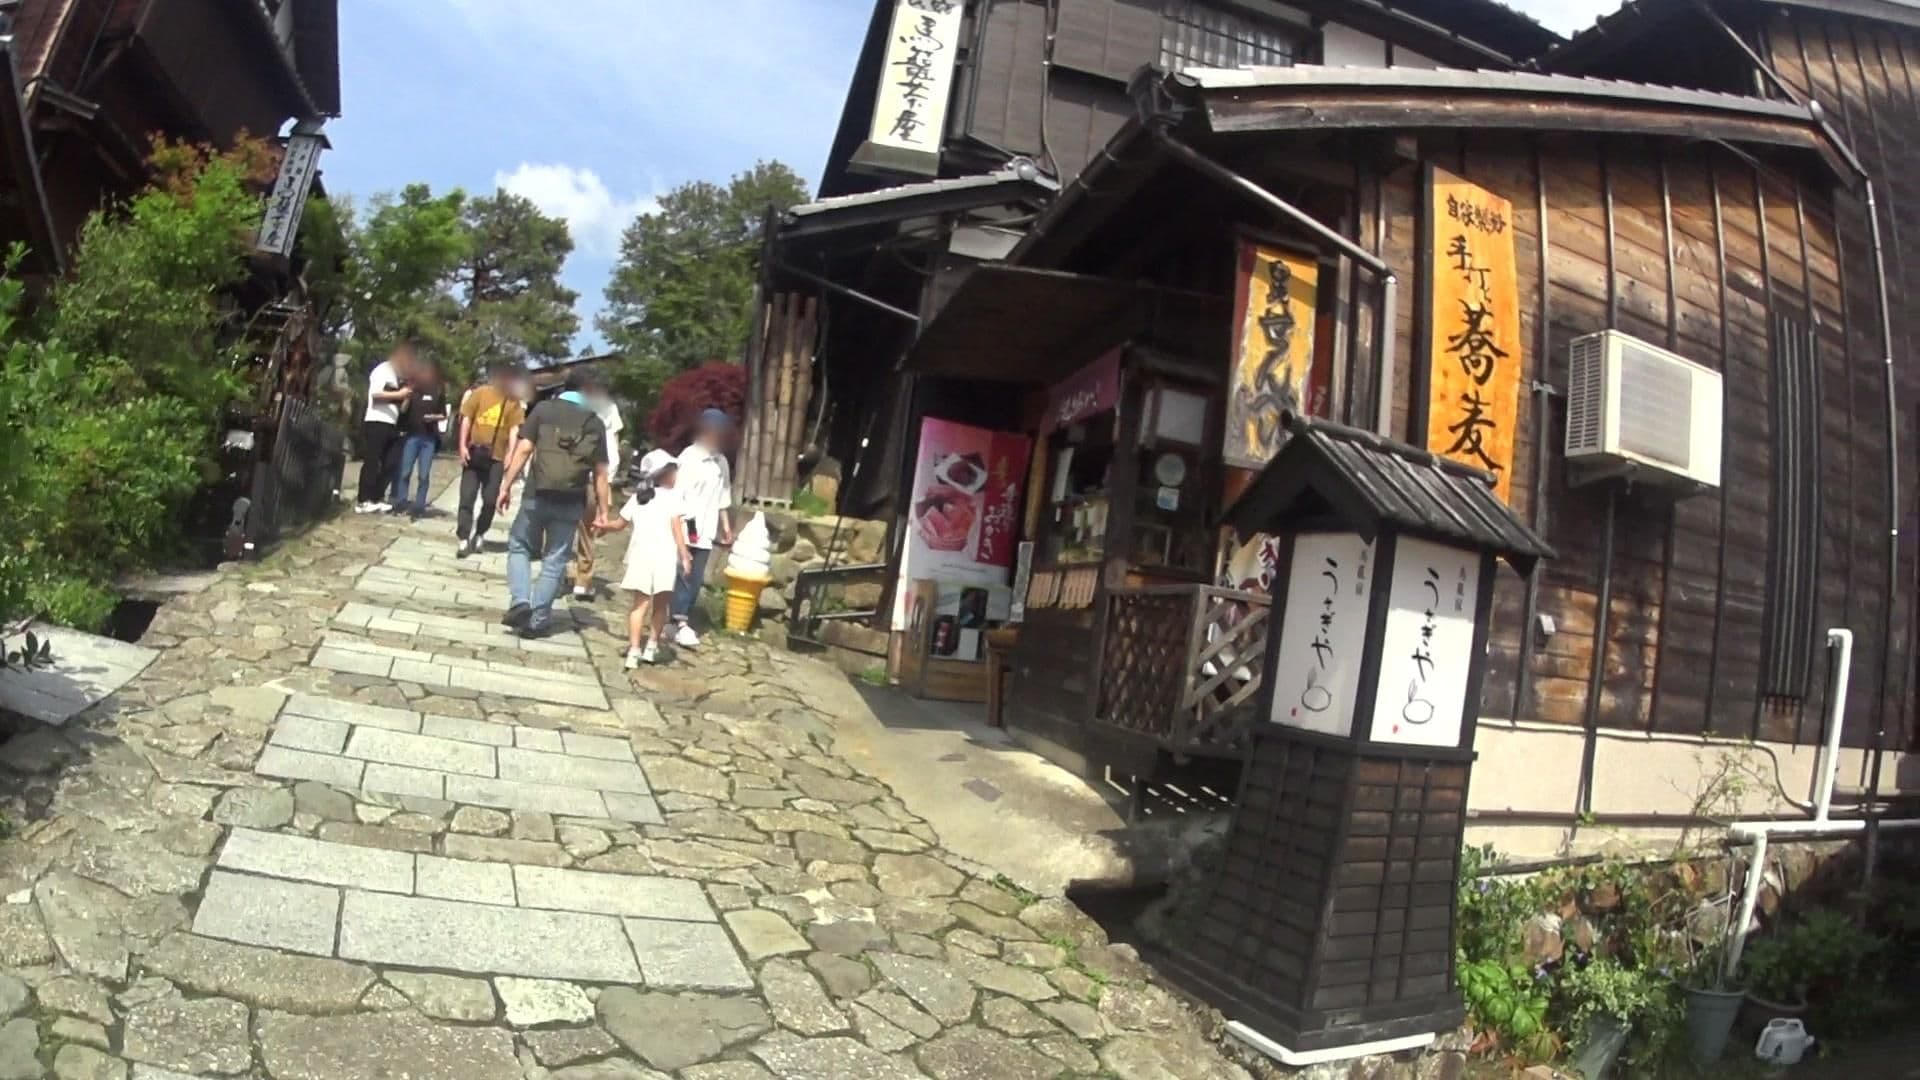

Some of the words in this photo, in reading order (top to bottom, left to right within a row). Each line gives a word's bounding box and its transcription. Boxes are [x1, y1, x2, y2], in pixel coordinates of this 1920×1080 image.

[1311, 556, 1339, 669] うさぎや
[1411, 567, 1441, 682] うさぎや
